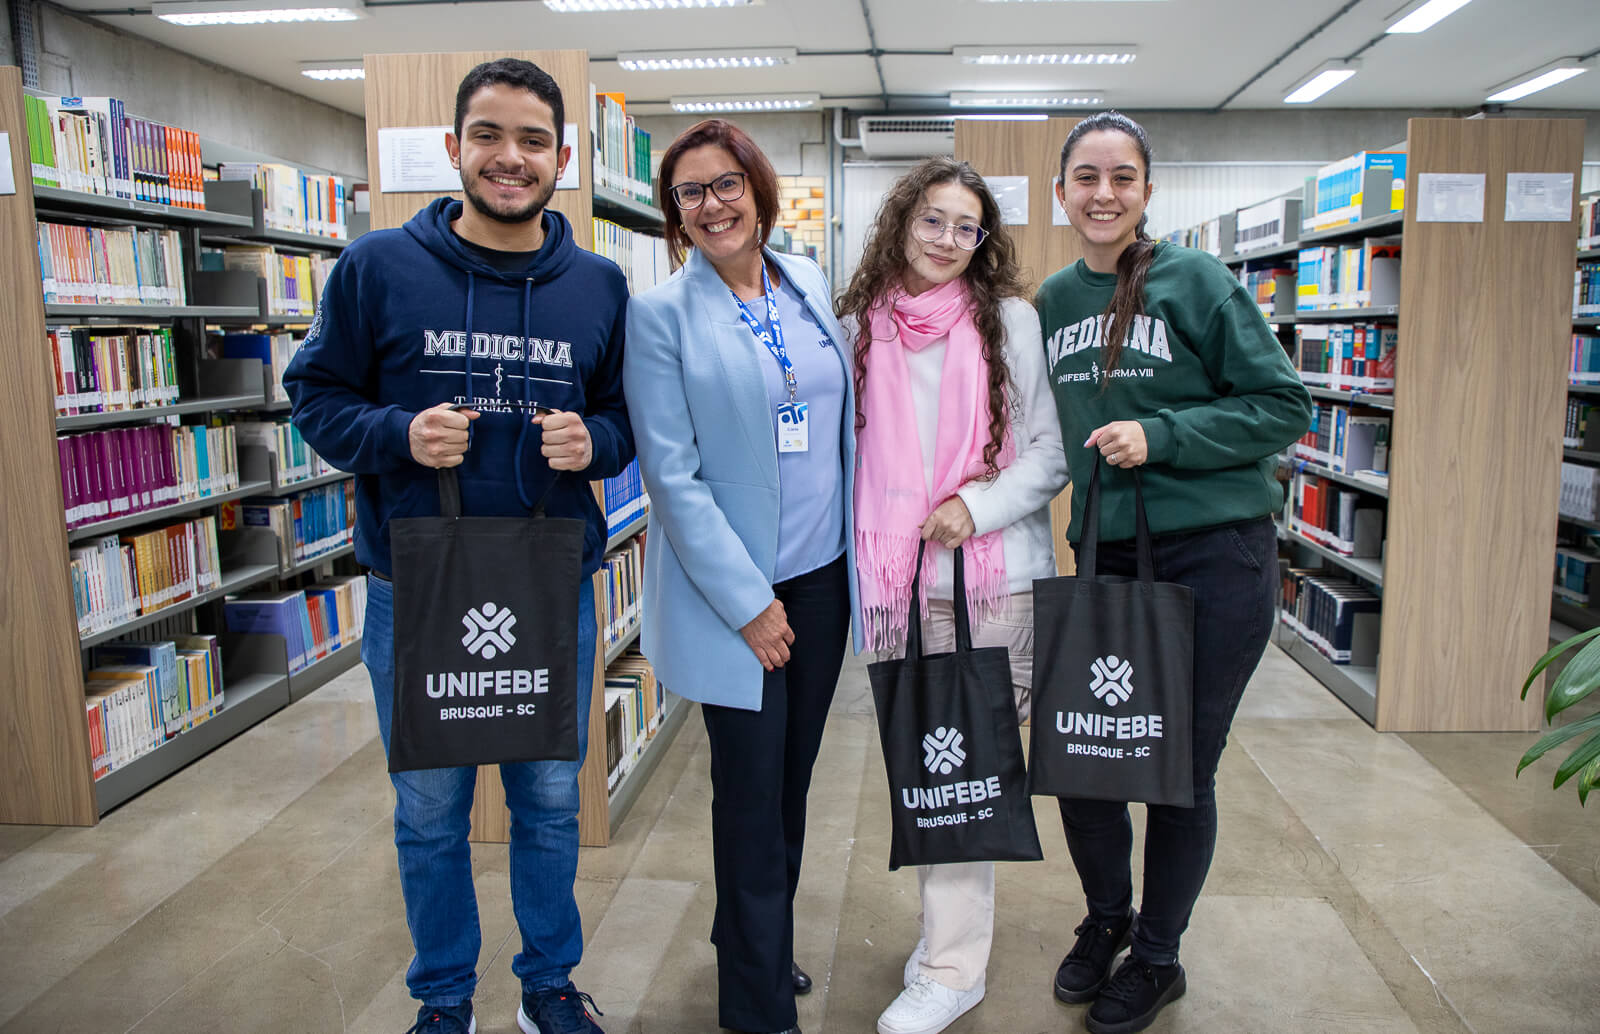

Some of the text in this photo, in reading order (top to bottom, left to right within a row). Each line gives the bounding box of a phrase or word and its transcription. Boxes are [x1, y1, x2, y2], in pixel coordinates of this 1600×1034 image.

[1138, 368, 1154, 377] VIII
[426, 668, 549, 699] UNIFEBE
[440, 705, 503, 721] BRUSQUE
[516, 703, 536, 716] SC
[1056, 711, 1163, 740] UNIFEBE
[1067, 743, 1124, 759] BRUSQUE
[1134, 746, 1151, 758] SC
[902, 775, 1002, 810] UNIFEBE
[917, 812, 968, 828] BRUSQUE
[977, 807, 994, 820] SC
